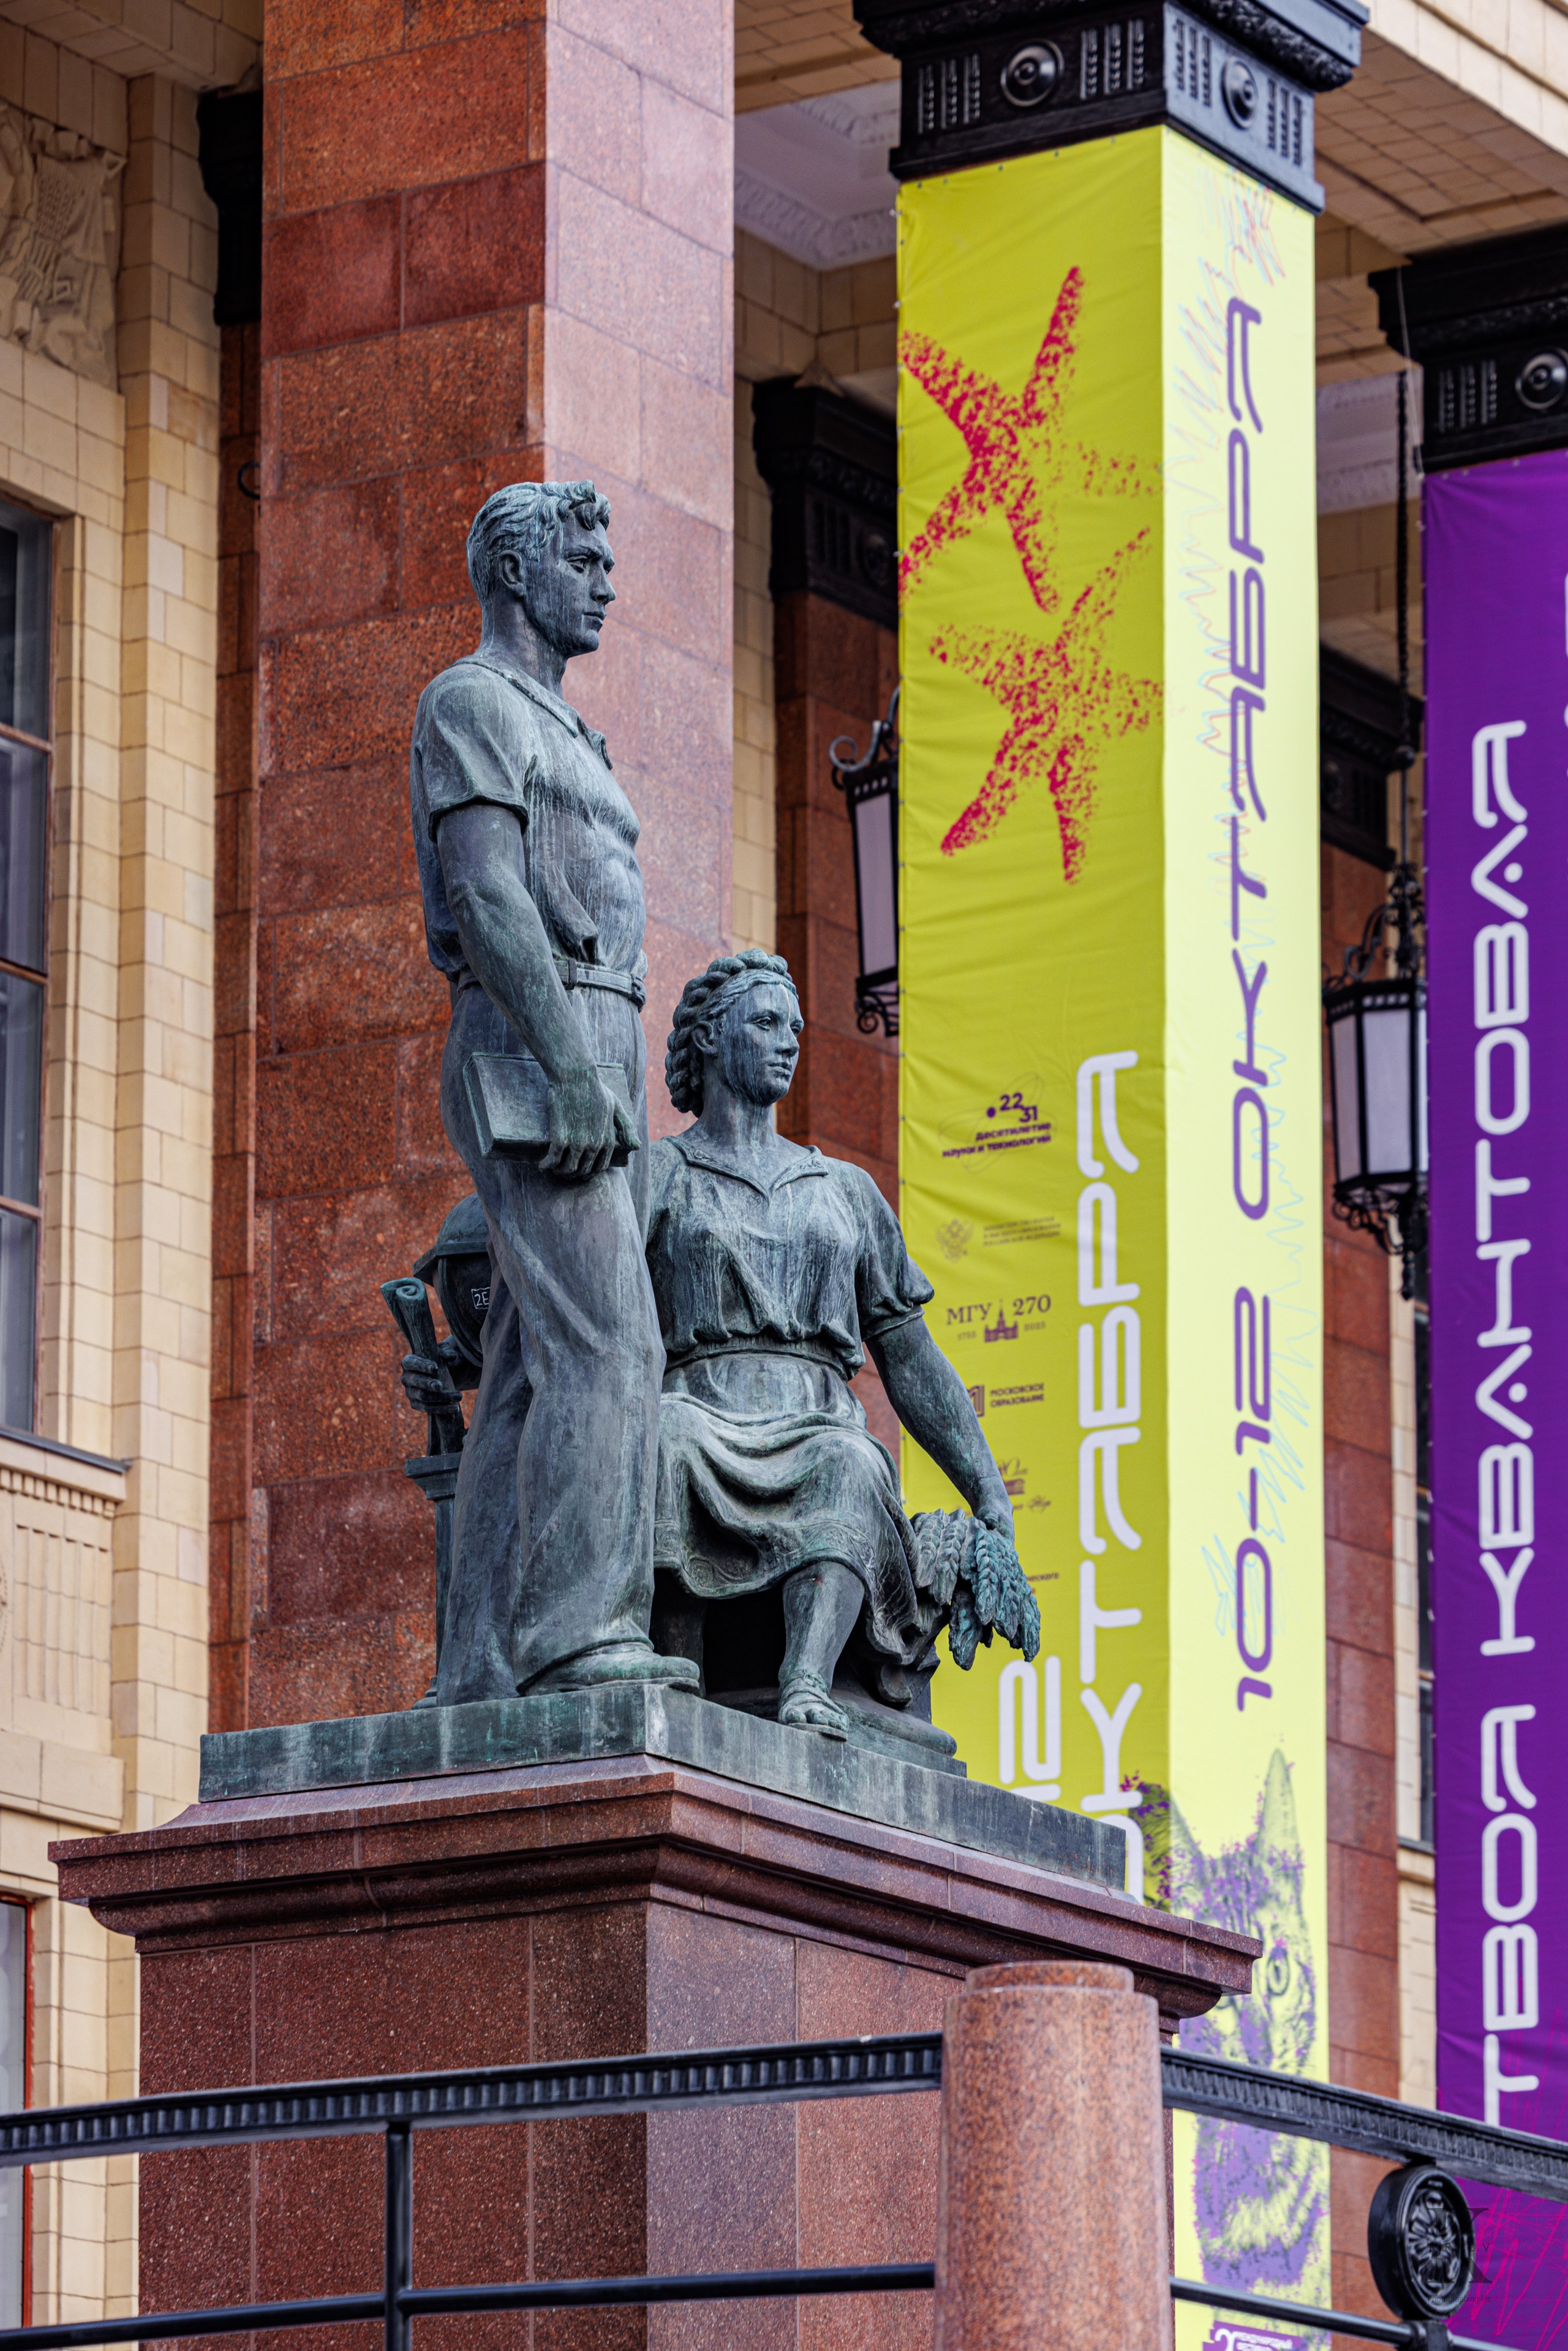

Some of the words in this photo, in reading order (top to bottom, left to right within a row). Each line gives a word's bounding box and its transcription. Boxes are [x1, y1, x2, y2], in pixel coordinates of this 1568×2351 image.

[1227, 297, 1268, 1219] ОКТЯБРЯ
[1000, 1092, 1023, 1112] 22
[1019, 1105, 1038, 1123] 31
[1472, 720, 1535, 1655] КВАНТОВАЯ
[946, 1302, 992, 1326] МГУ
[1013, 1294, 1051, 1316] 270
[1235, 1288, 1272, 1710] 10-12
[1480, 1705, 1539, 2126] ТВОЯ
